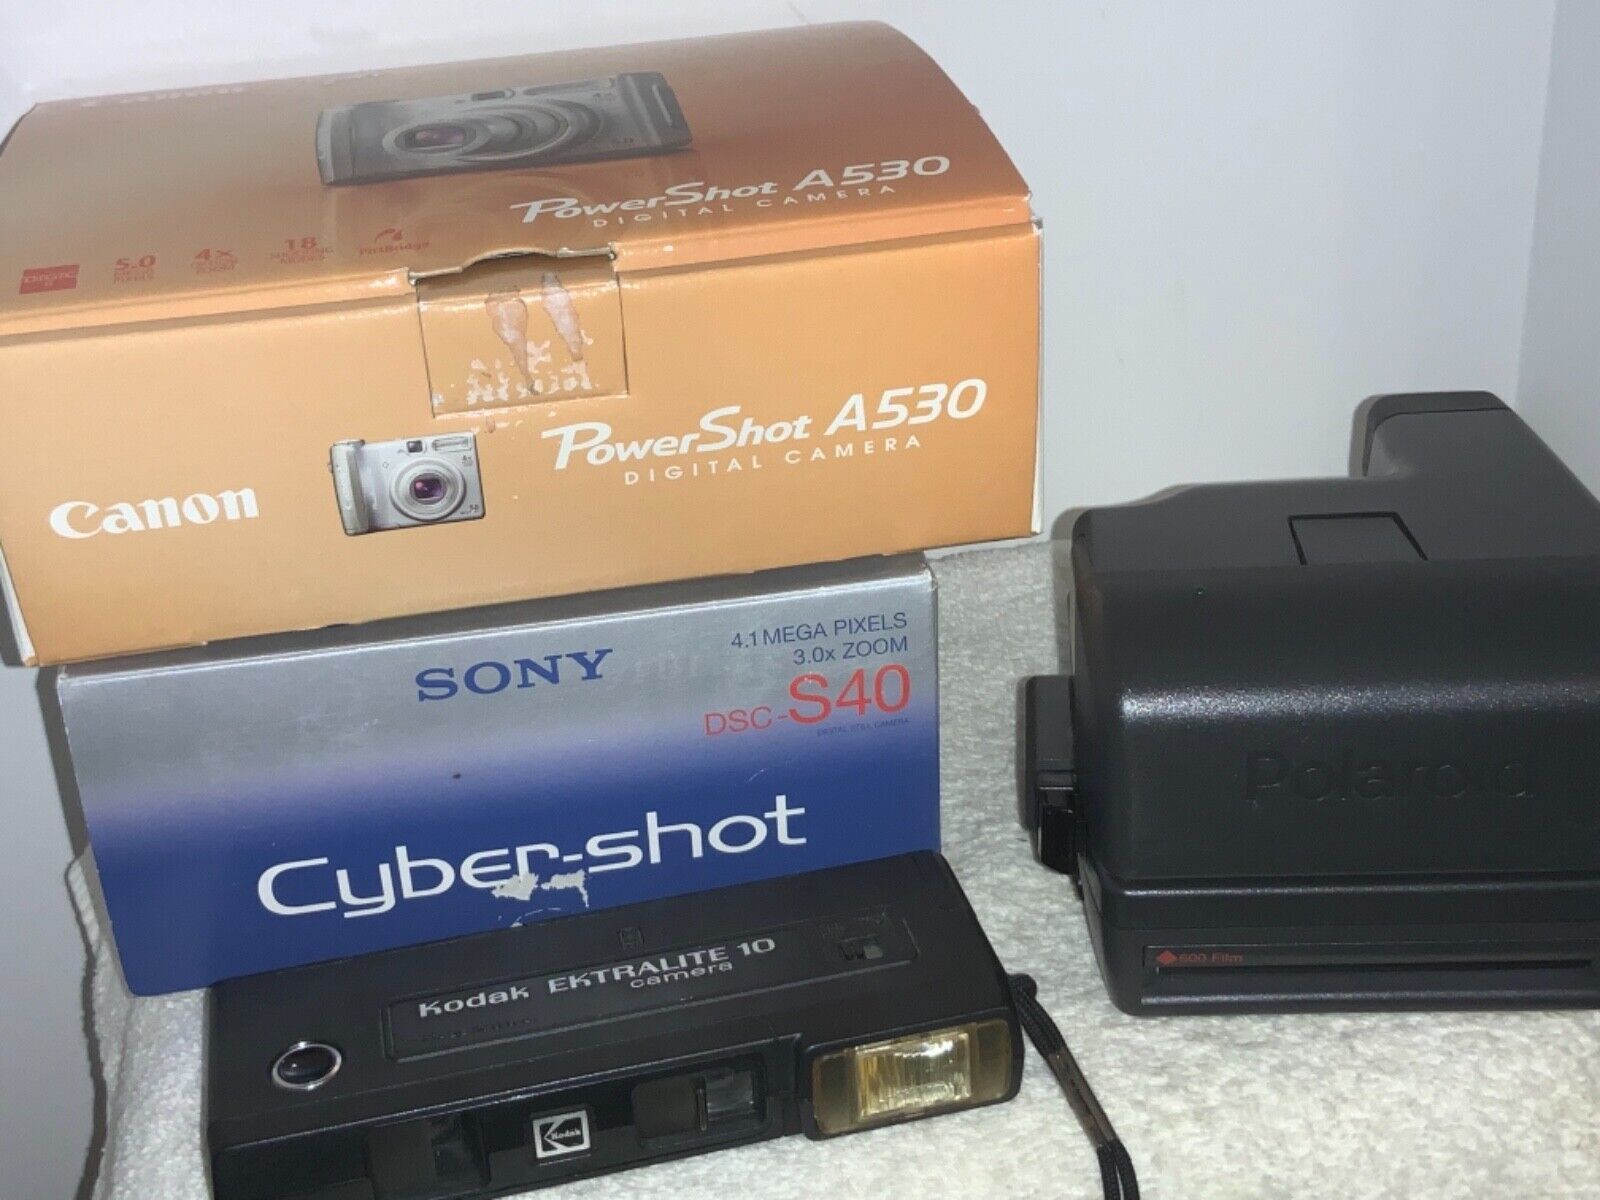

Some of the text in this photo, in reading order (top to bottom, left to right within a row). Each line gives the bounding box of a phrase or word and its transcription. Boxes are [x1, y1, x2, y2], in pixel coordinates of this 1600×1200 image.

[510, 155, 951, 223] PowerShot A530
[593, 185, 896, 228] DIGITAL CAMERA
[115, 254, 157, 271] 5.0
[541, 378, 988, 470] PowerShot A530
[623, 435, 922, 486] DIGITAL CAMERA
[49, 487, 260, 539] Canon
[731, 611, 909, 649] 4.1 MEGA PIXELS
[793, 636, 908, 665] 3.0x ZOOM
[415, 648, 613, 702] SONY
[704, 663, 911, 736] DSC-S40
[257, 794, 807, 919] Cyber-shot
[418, 936, 777, 1019] Kodak EKTRALITE 10
[629, 960, 733, 989] camera
[1212, 951, 1243, 963] Film
